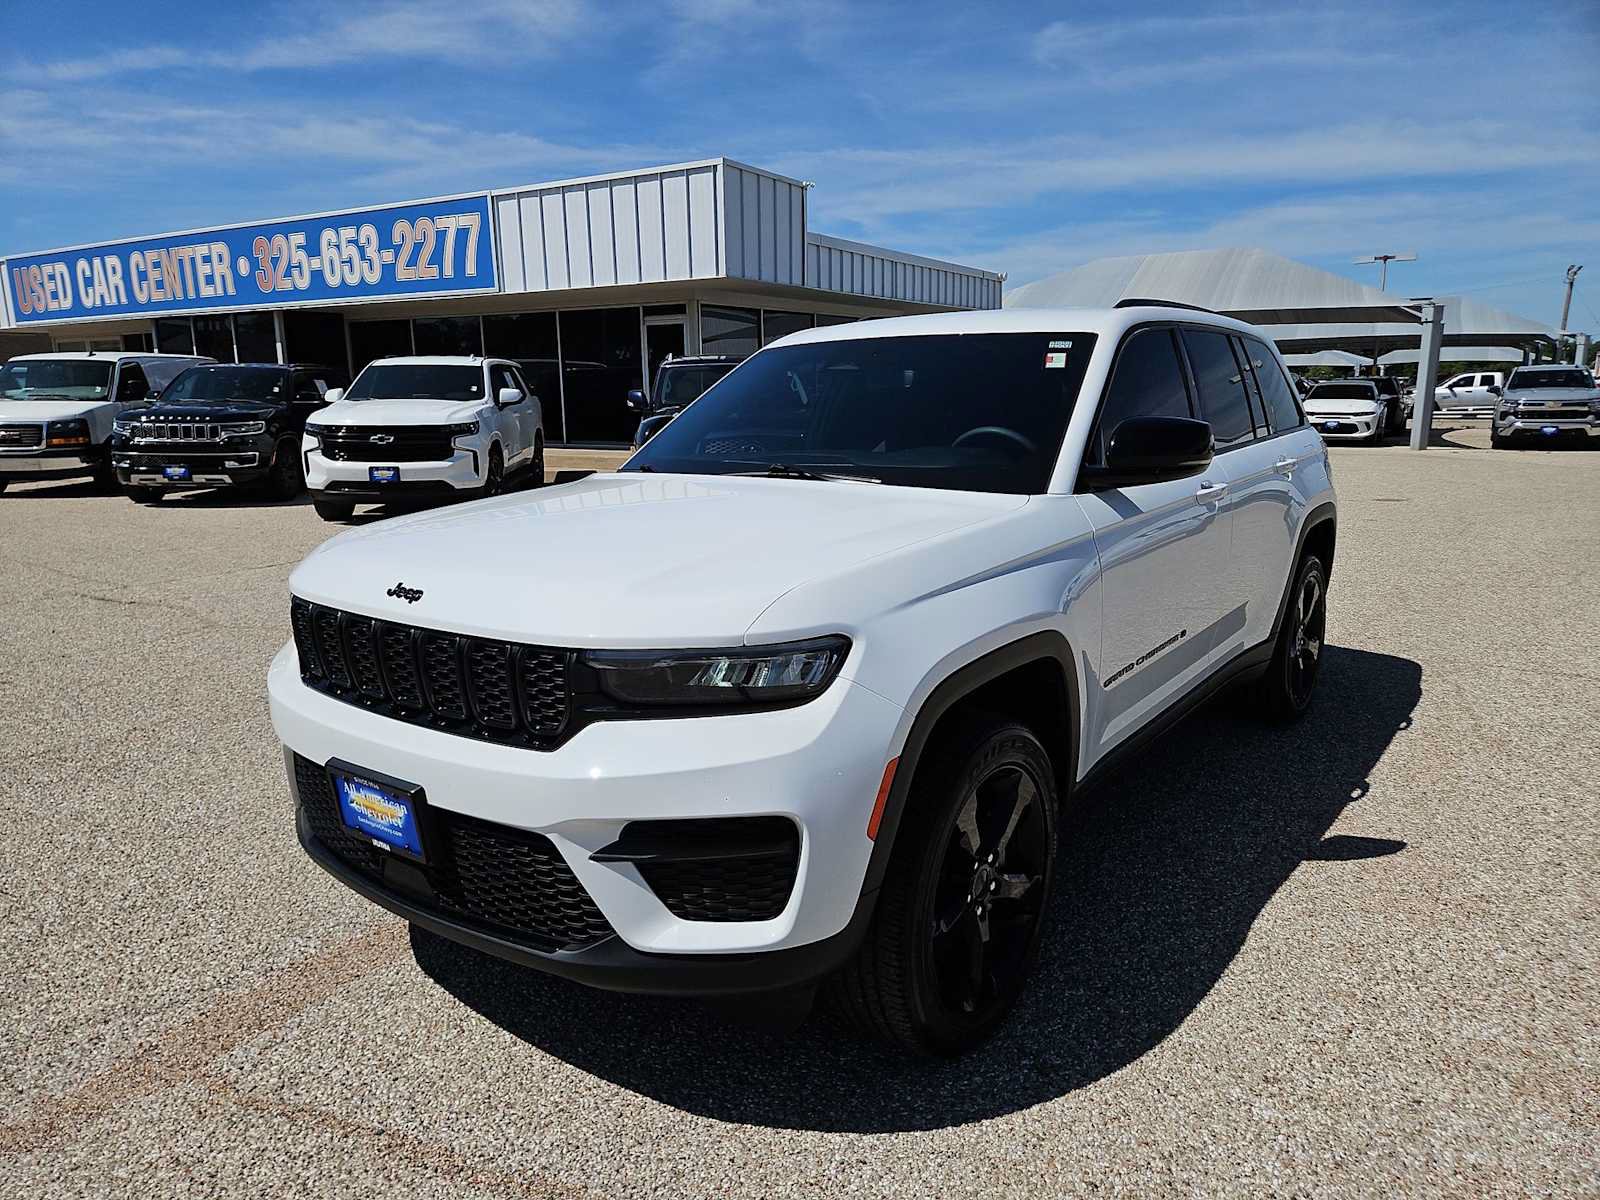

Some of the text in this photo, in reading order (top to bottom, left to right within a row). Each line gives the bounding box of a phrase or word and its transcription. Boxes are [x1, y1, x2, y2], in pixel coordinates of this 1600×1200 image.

[13, 212, 481, 315] USED CAR CENTER 325-653-2277
[386, 582, 424, 604] Jeep
[1103, 662, 1135, 688] GRAND
[354, 801, 403, 828] Chevrolet
[360, 787, 408, 815] American
